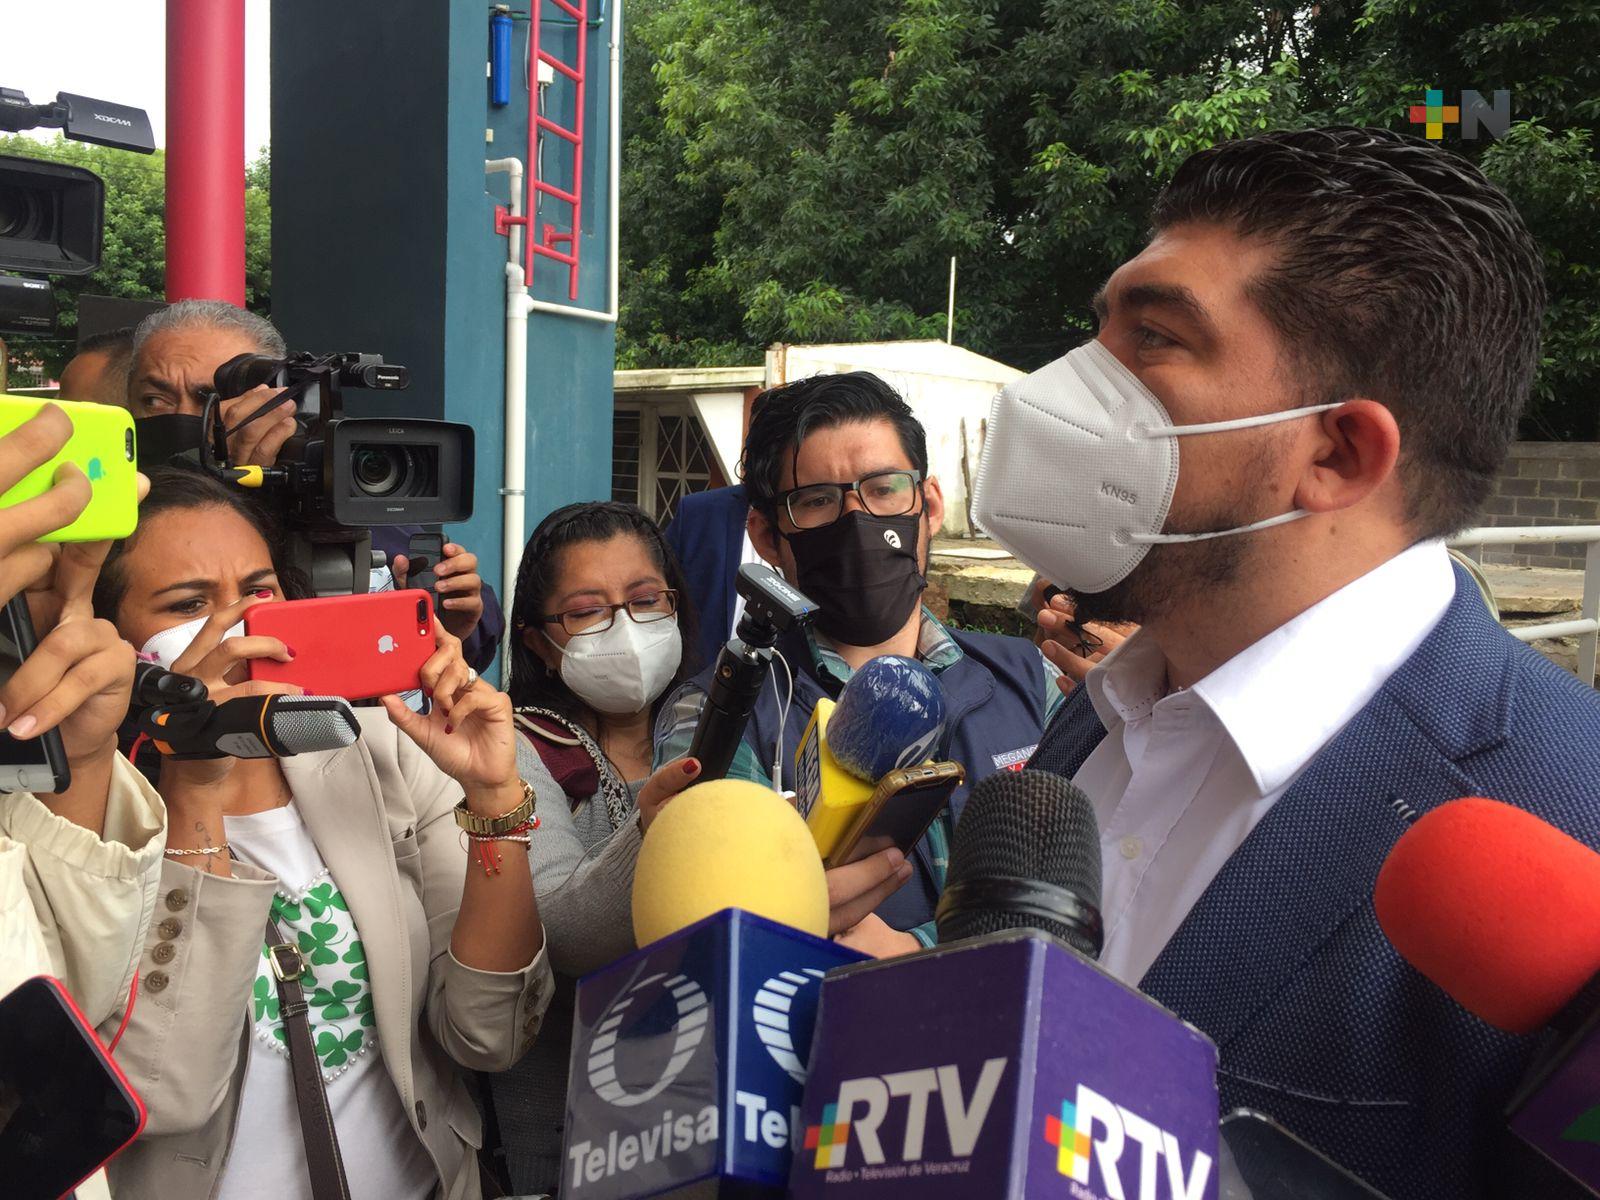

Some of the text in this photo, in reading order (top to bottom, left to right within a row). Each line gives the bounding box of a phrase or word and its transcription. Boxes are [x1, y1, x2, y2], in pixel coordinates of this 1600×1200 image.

[1100, 481, 1137, 505] KN95
[569, 1104, 719, 1189] Televisa
[812, 1057, 1008, 1169] RTV
[1056, 1083, 1213, 1200] RTV
[908, 1163, 922, 1177] de
[924, 1160, 971, 1175] Veracruz
